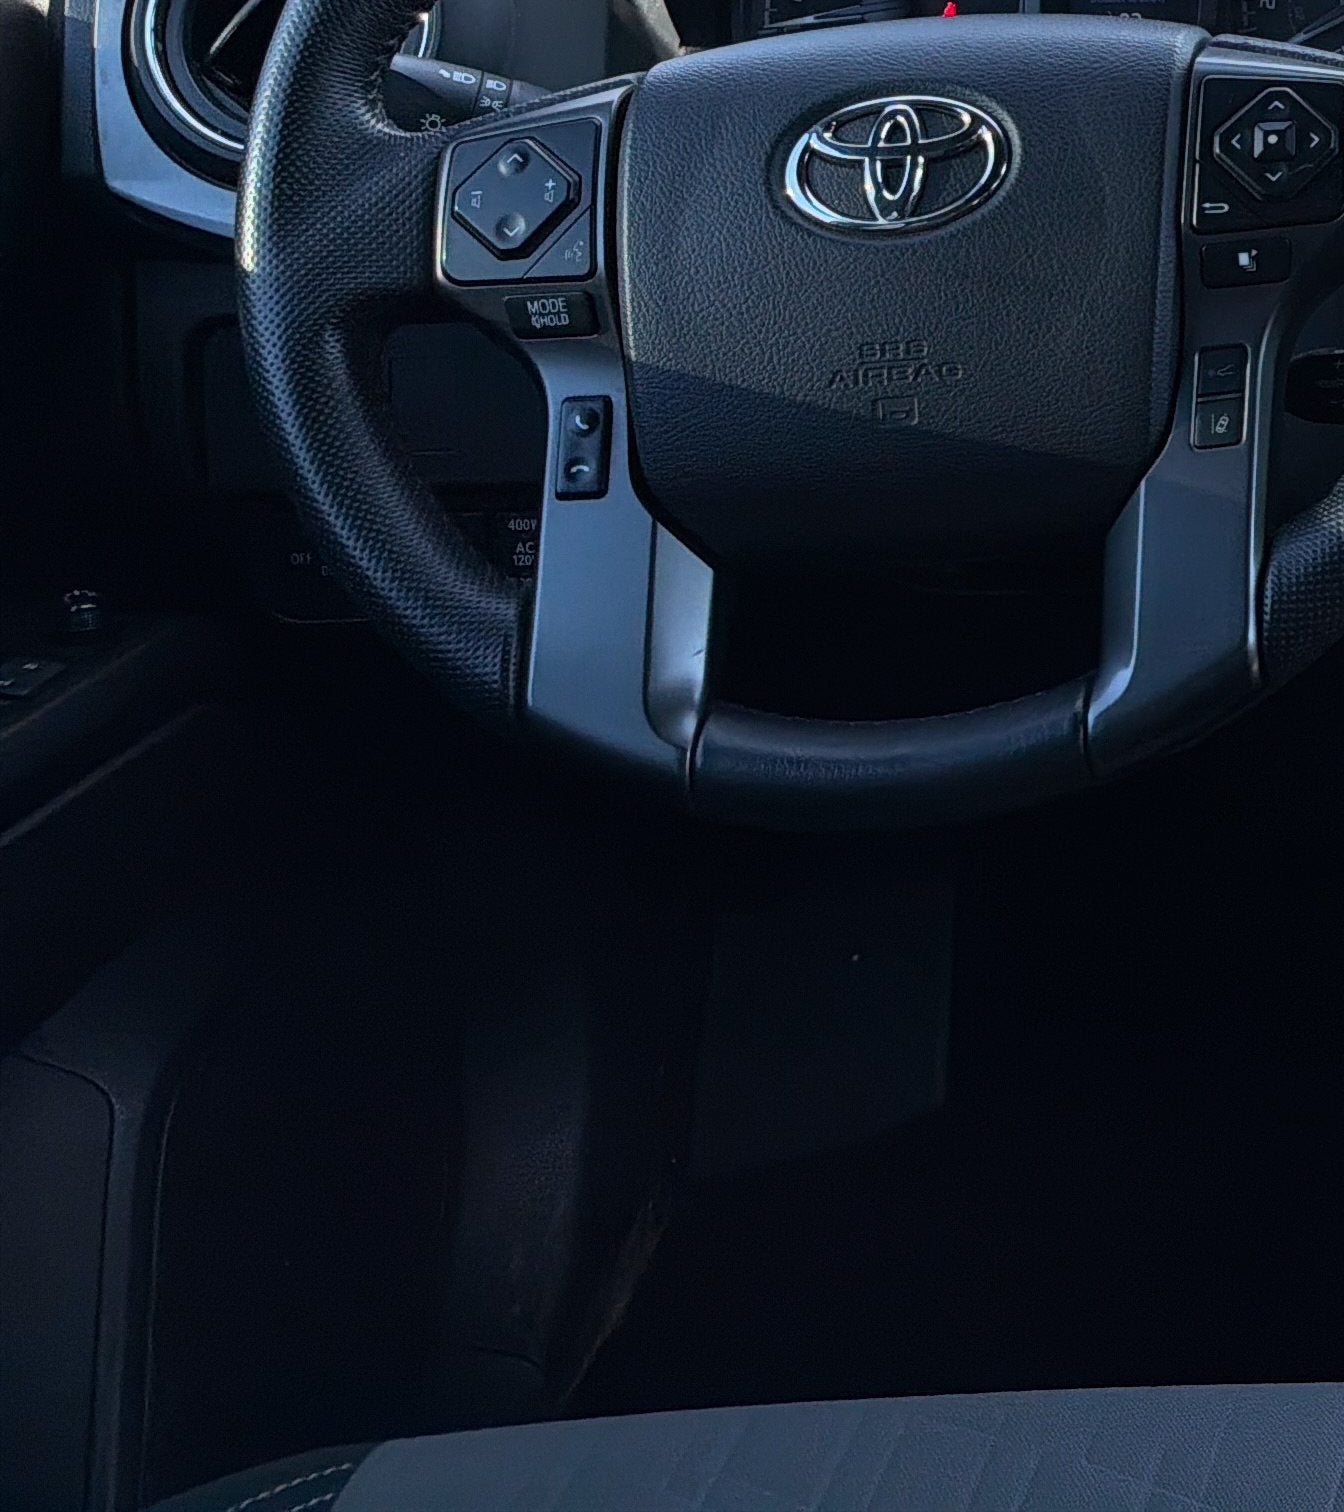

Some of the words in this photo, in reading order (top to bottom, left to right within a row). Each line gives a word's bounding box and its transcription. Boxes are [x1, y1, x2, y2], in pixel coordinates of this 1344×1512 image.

[526, 297, 568, 315] MODE
[540, 313, 569, 327] HOLD
[516, 541, 536, 554] AC
